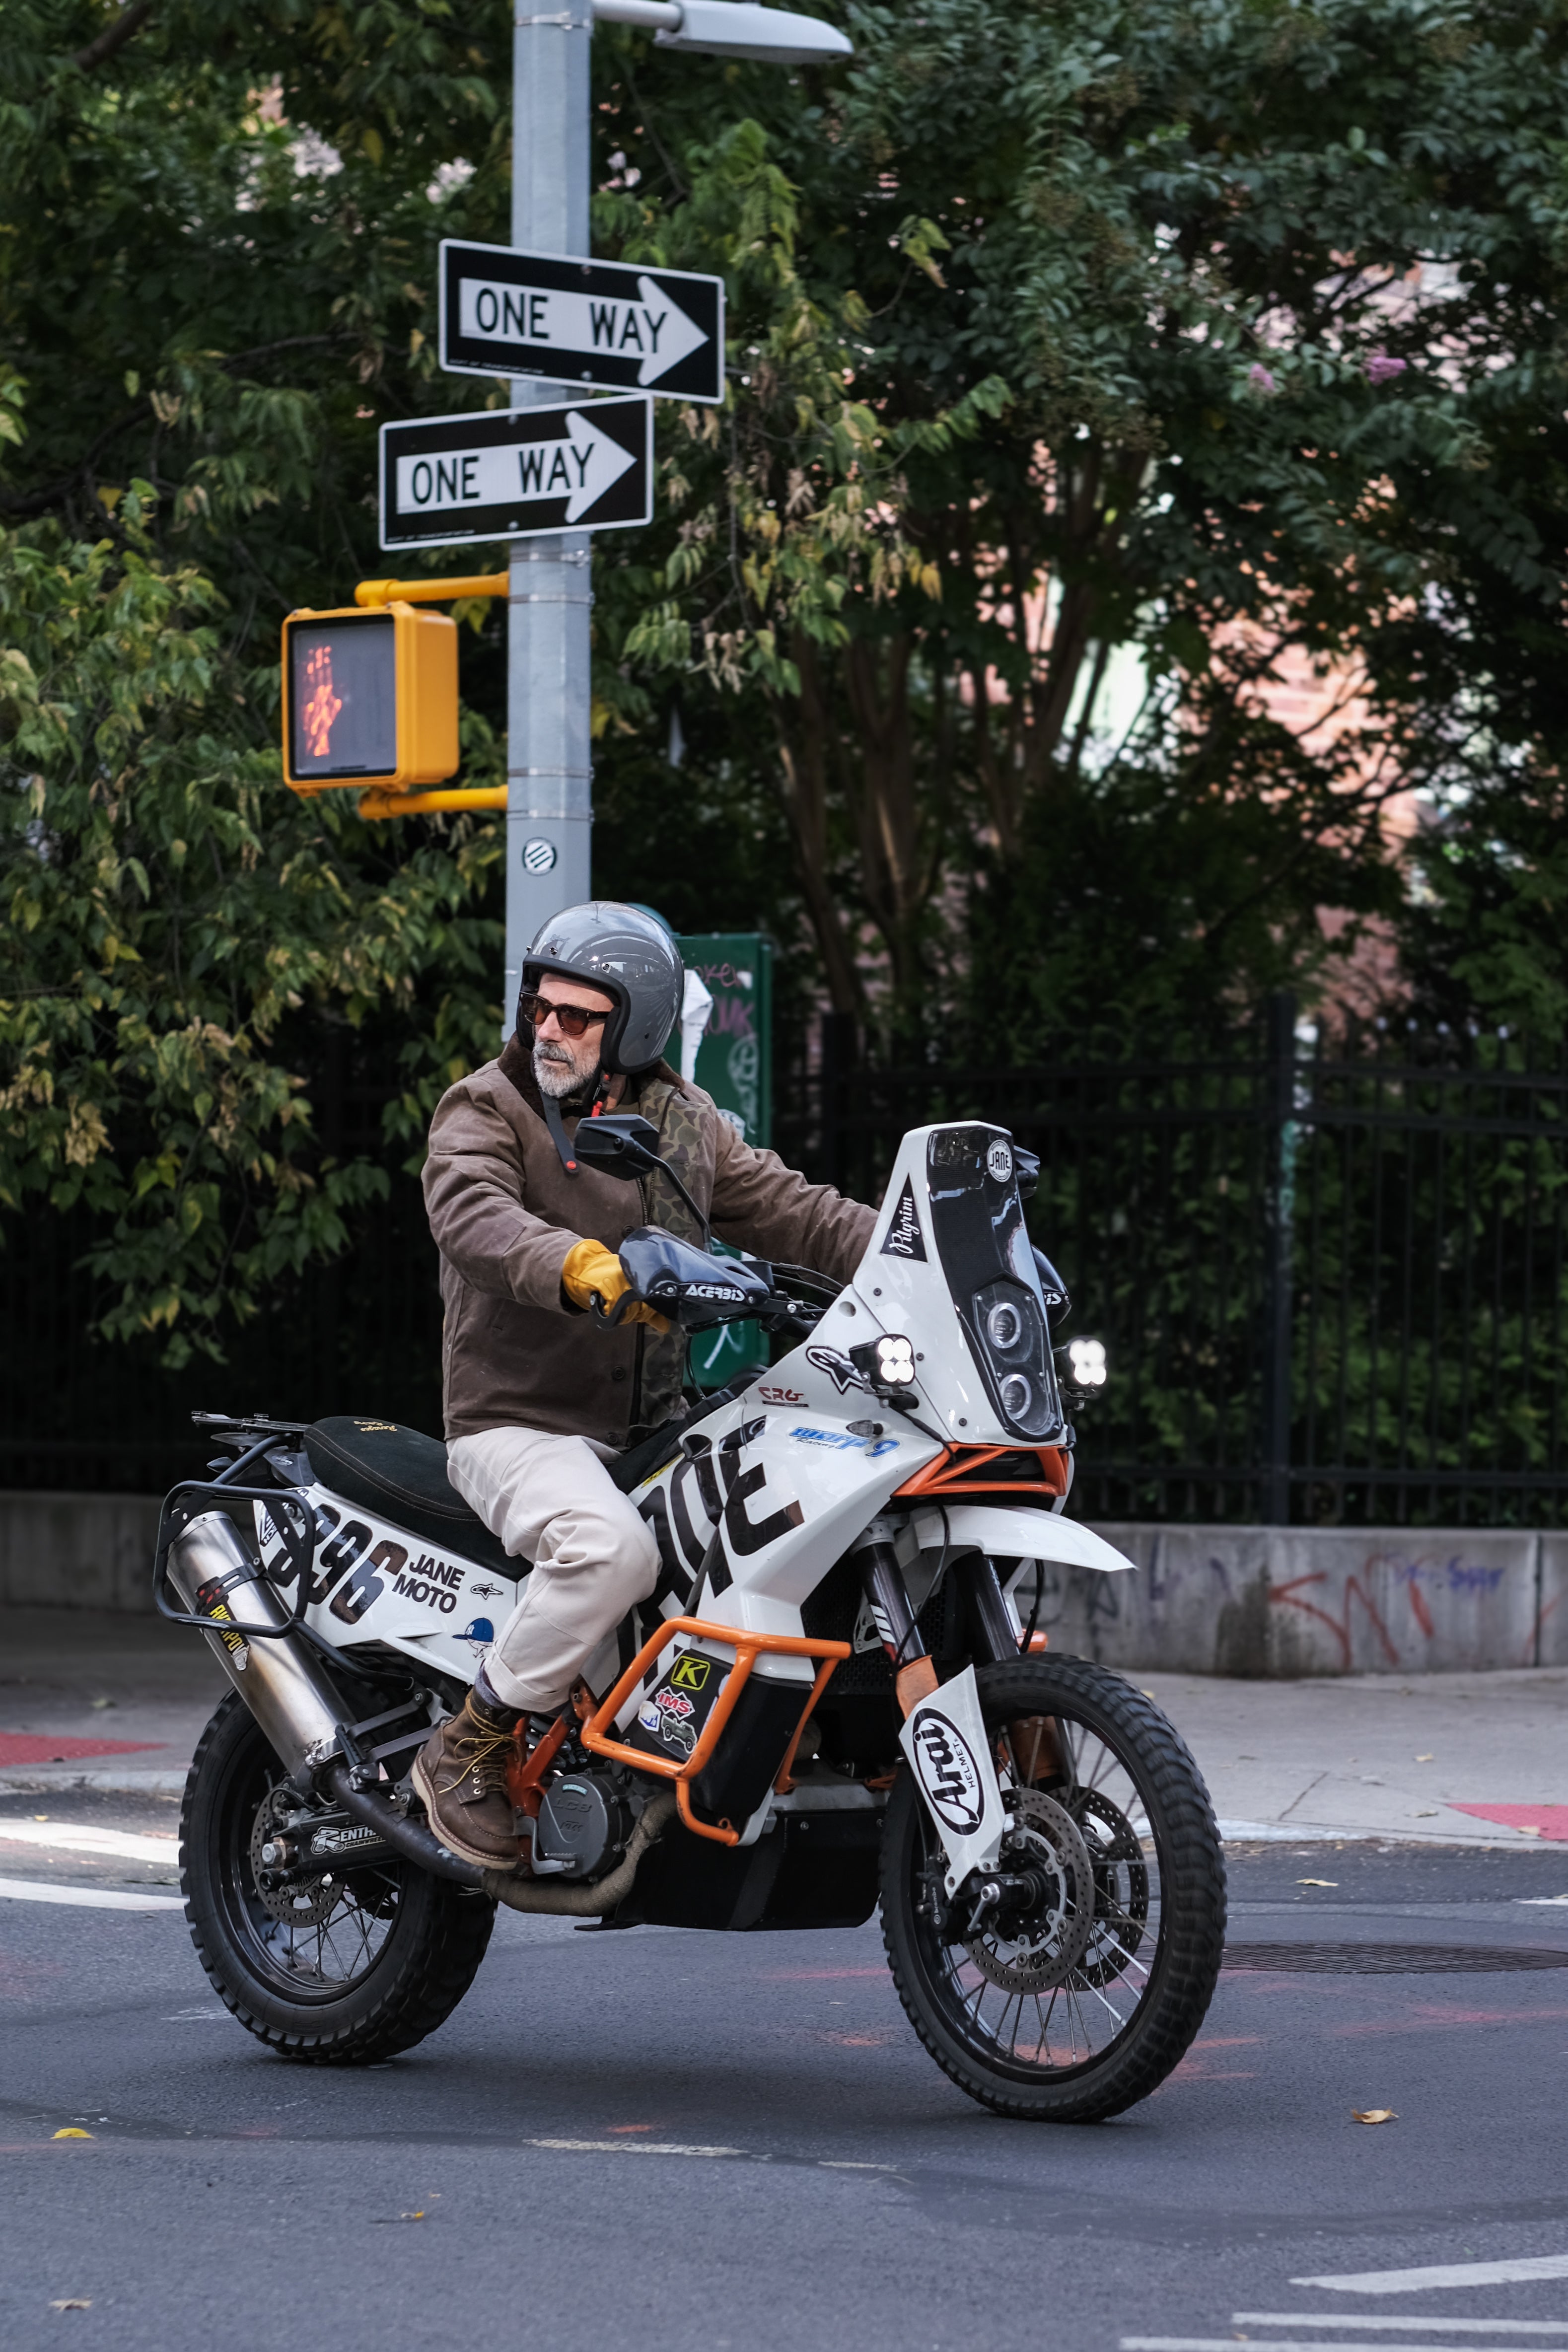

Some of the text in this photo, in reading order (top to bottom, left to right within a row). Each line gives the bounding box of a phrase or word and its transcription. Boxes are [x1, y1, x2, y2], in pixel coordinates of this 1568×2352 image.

[476, 287, 668, 353] ONE WAY
[412, 442, 596, 504] ONE WAY
[990, 1151, 1010, 1171] JANE
[889, 1196, 920, 1254] Pilgrim
[759, 1387, 804, 1401] CRG
[795, 1437, 835, 1448] Racing
[865, 1439, 900, 1457] 9
[409, 1554, 466, 1591] JANE
[392, 1573, 457, 1614] MOTO
[674, 1660, 707, 1686] K
[658, 1692, 691, 1713] IMS
[914, 1723, 980, 1823] Arai
[953, 1742, 976, 1788] HELMET
